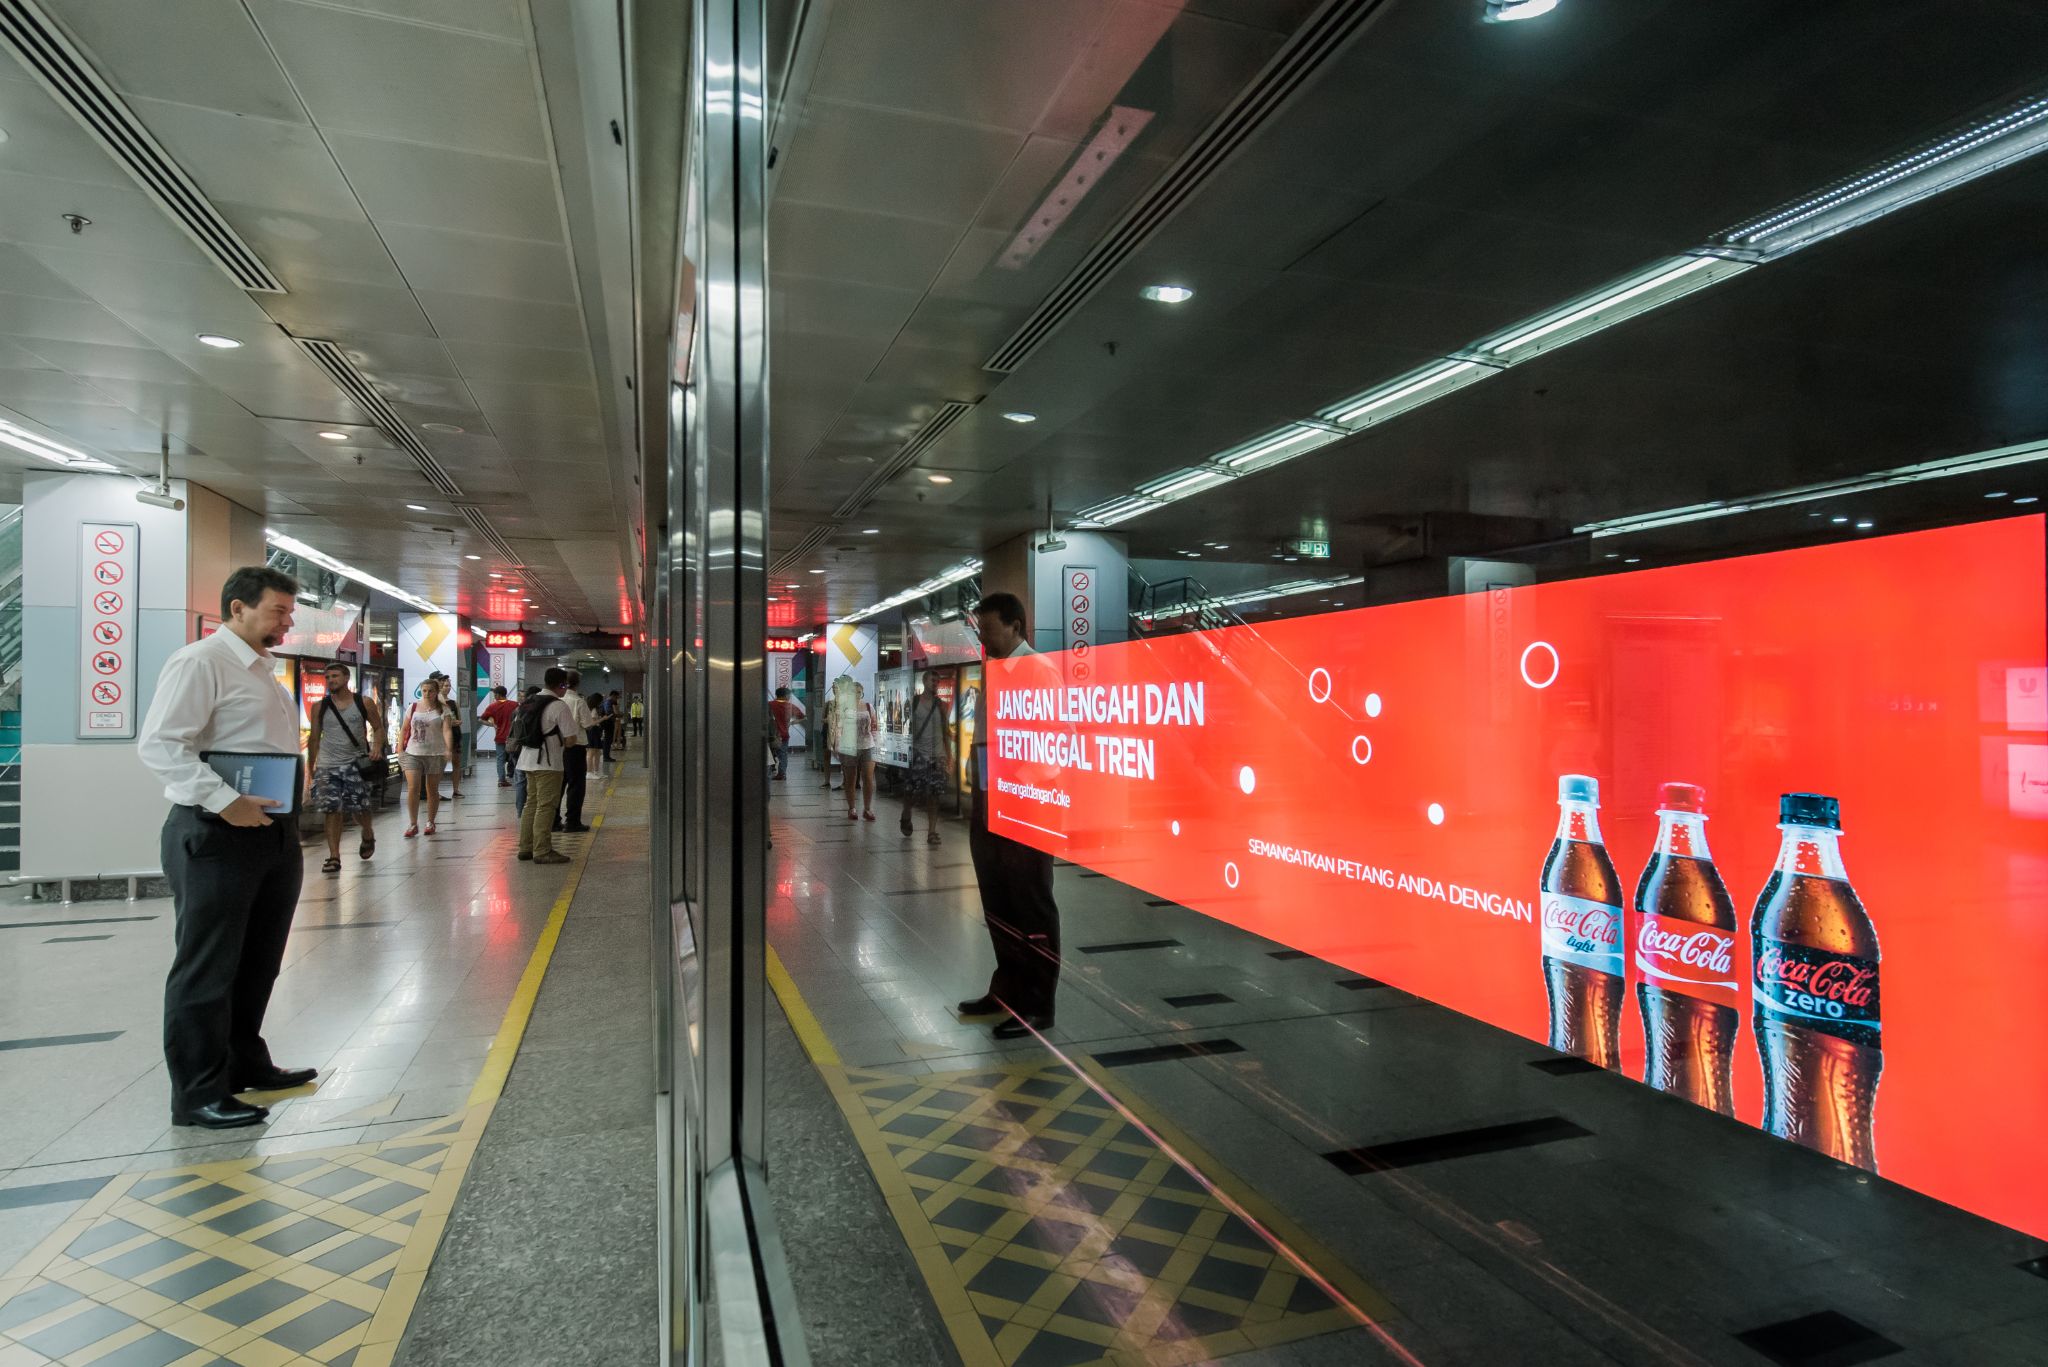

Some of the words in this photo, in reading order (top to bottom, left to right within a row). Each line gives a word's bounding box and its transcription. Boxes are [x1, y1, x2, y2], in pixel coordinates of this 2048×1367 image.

[488, 634, 523, 645] 16:33
[996, 687, 1054, 721] JANGAN
[1058, 684, 1139, 725] LENGAH
[1145, 681, 1205, 727] DAN
[996, 729, 1093, 771] TERTINGGAL
[1095, 736, 1155, 781] TREN
[997, 777, 1071, 809] #semangatdenganCoke
[1248, 838, 1336, 875] SEMANGATKAN
[1337, 858, 1394, 889] PETANG
[1397, 872, 1446, 902] ANDA
[1449, 885, 1532, 924] DENGAN
[1544, 900, 1620, 945] Coca-Cola
[1566, 935, 1597, 954] light
[1638, 920, 1733, 975] Coca-Cola
[1756, 946, 1877, 1007] Coca-Cola
[1784, 989, 1845, 1019] zero
